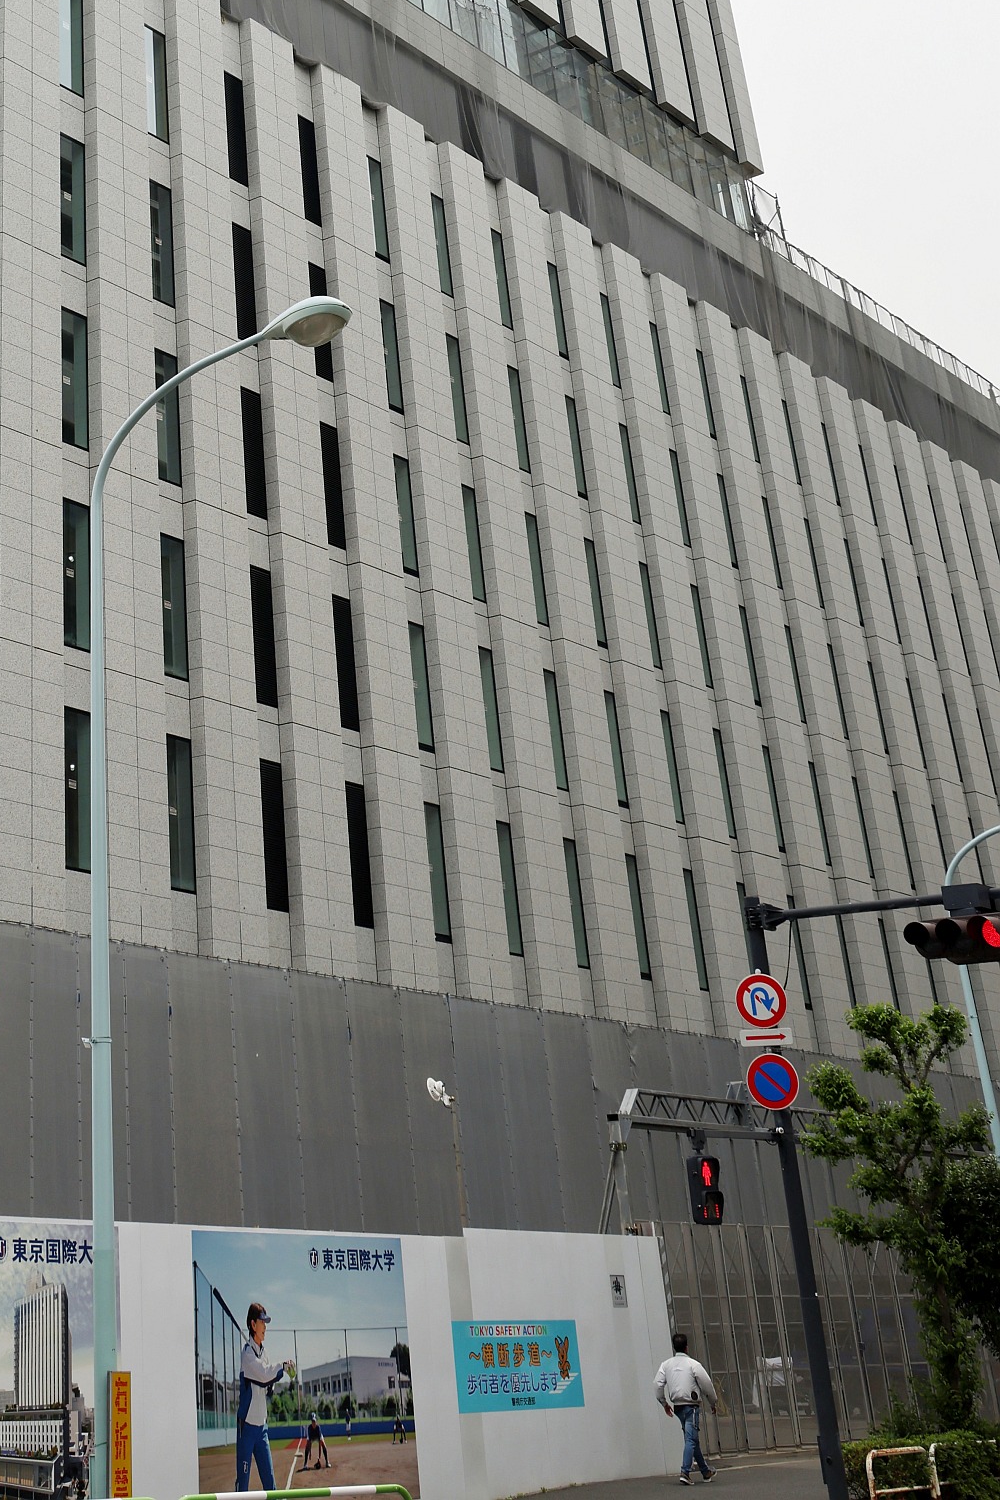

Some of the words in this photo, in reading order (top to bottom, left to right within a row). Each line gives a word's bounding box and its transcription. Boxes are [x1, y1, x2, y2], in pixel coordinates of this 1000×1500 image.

[322, 1248, 395, 1271] 東京国際大学
[469, 1326, 494, 1336] TOKYO
[495, 1325, 521, 1336] SAFETY
[522, 1325, 548, 1336] ACTION
[467, 1372, 558, 1395] 歩行者を優先します
